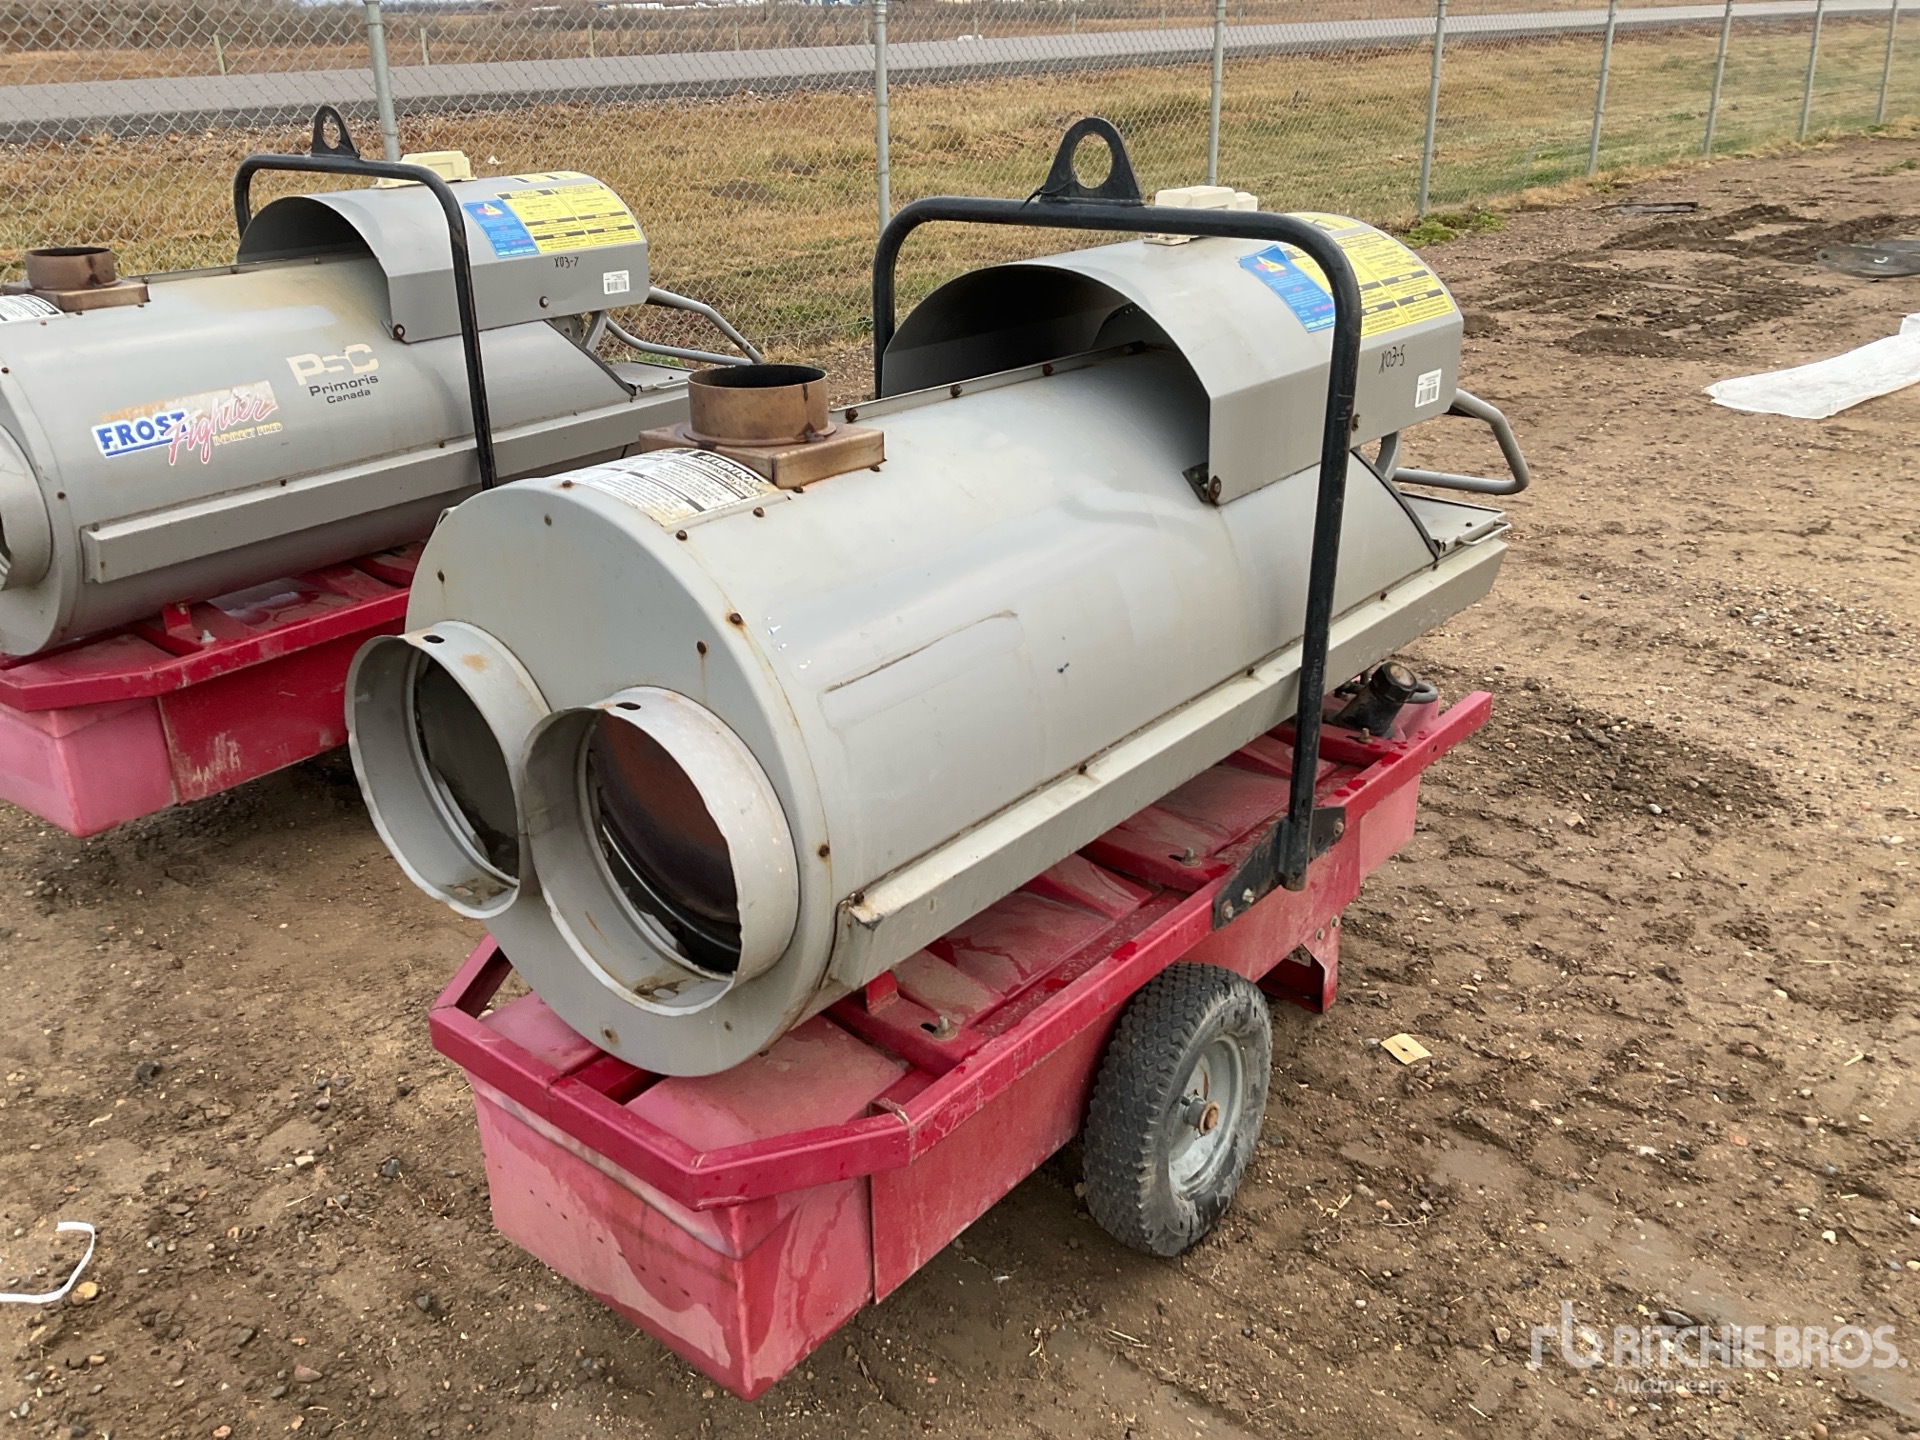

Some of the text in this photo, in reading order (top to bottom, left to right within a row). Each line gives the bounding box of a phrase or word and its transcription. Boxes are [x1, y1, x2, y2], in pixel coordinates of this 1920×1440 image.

[308, 374, 379, 397] Primoris
[326, 389, 371, 404] Canada
[95, 391, 278, 465] FROST Fighter
